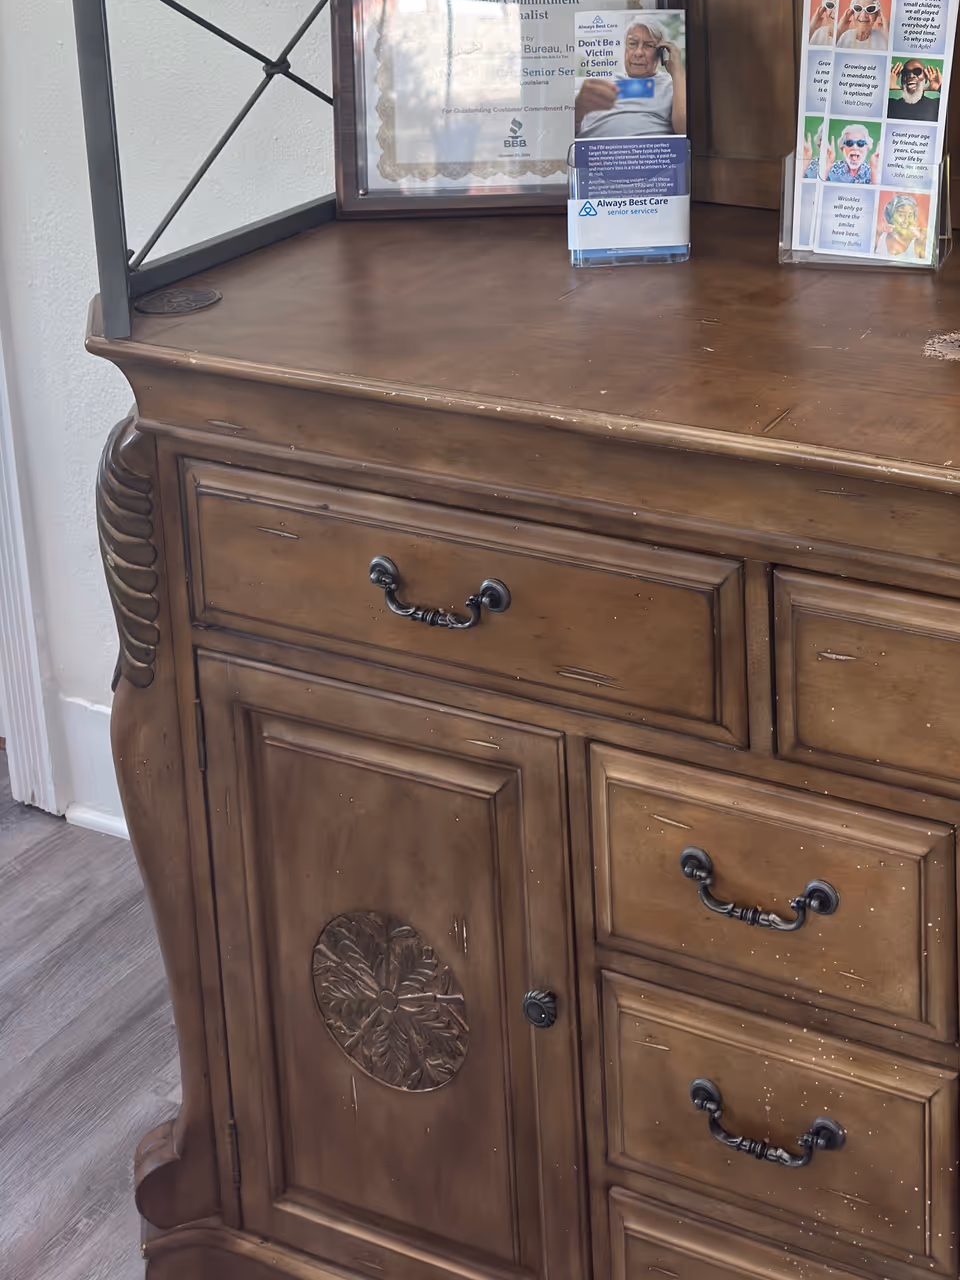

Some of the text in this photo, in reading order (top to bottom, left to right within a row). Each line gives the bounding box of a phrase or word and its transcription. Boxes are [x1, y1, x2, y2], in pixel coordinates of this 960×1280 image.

[578, 39, 601, 48] Don't
[524, 44, 562, 54] Bureau,
[585, 49, 614, 57] Victim
[580, 59, 618, 68] of Senior
[844, 63, 866, 71] Growing
[522, 67, 555, 77] Senior
[597, 197, 669, 209] Always Best Care
